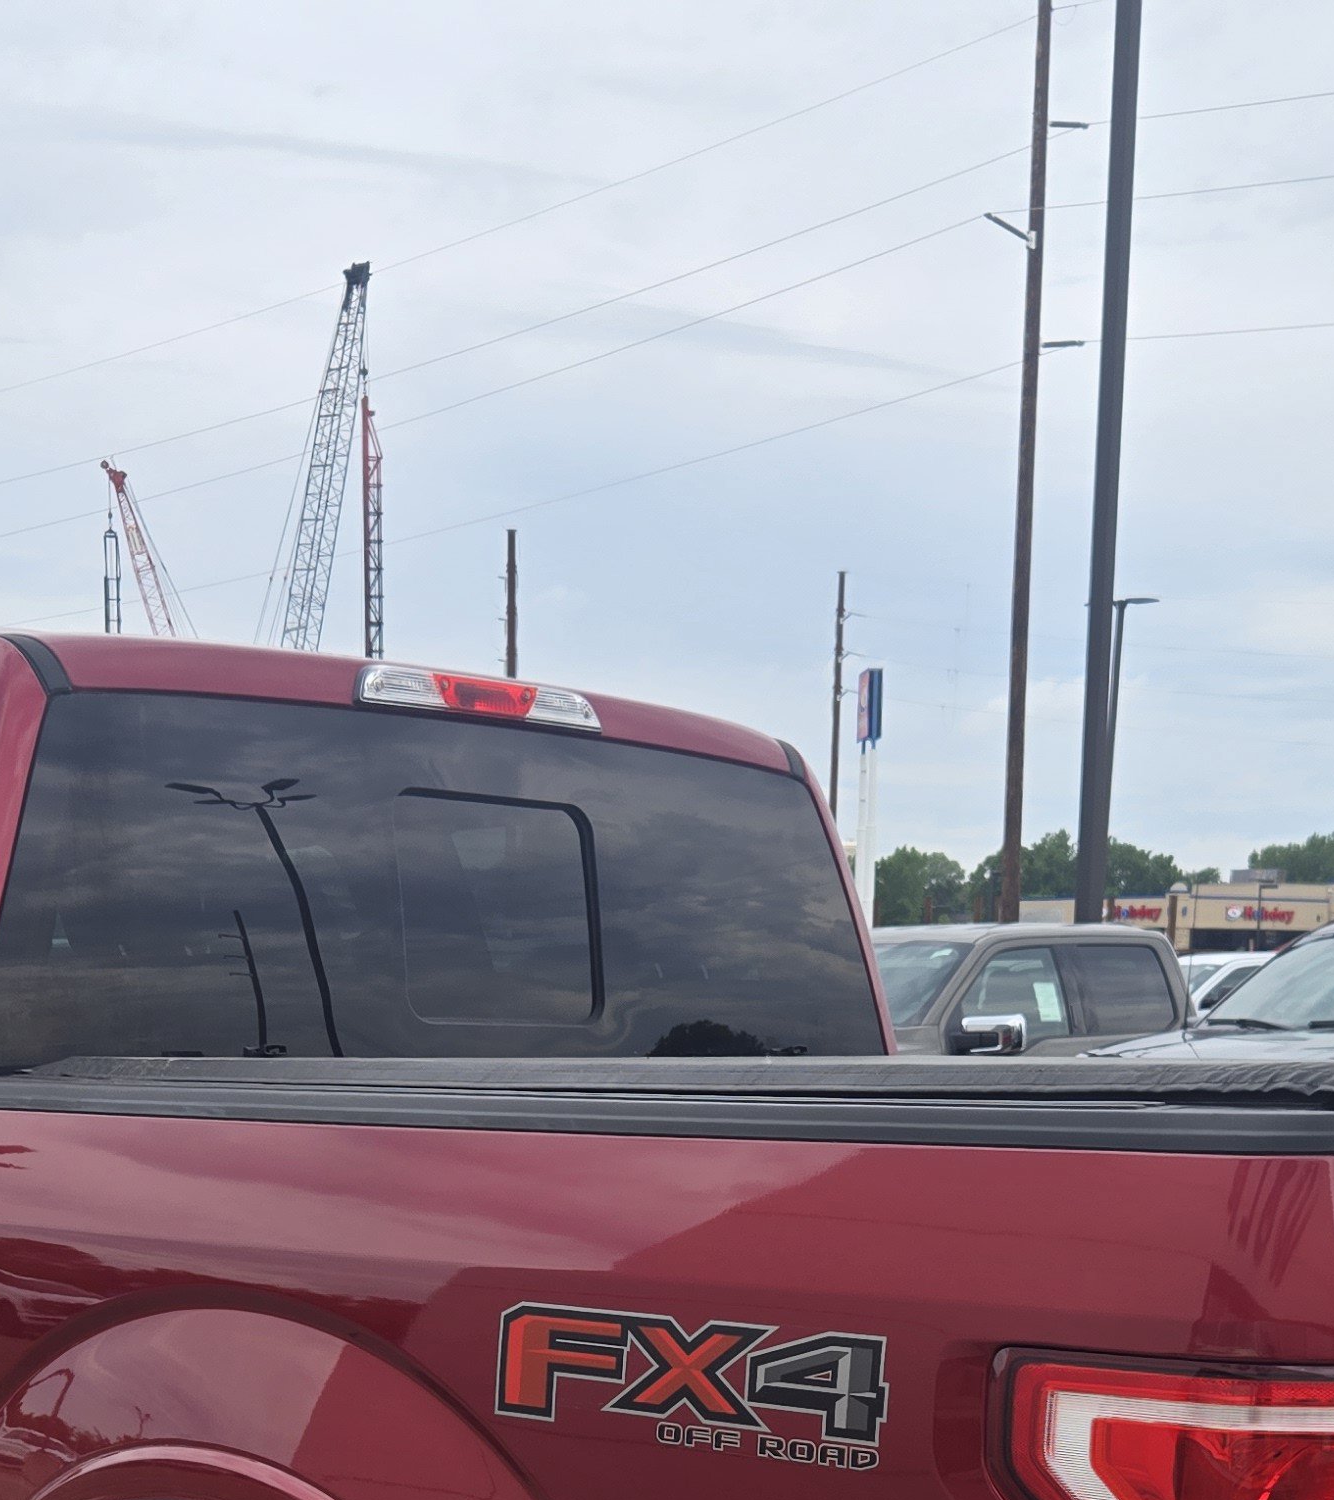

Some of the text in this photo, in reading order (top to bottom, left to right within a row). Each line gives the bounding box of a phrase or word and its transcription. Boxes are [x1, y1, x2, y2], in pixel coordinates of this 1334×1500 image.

[495, 1301, 890, 1447] FX4
[655, 1421, 880, 1471] OFF ROAD
